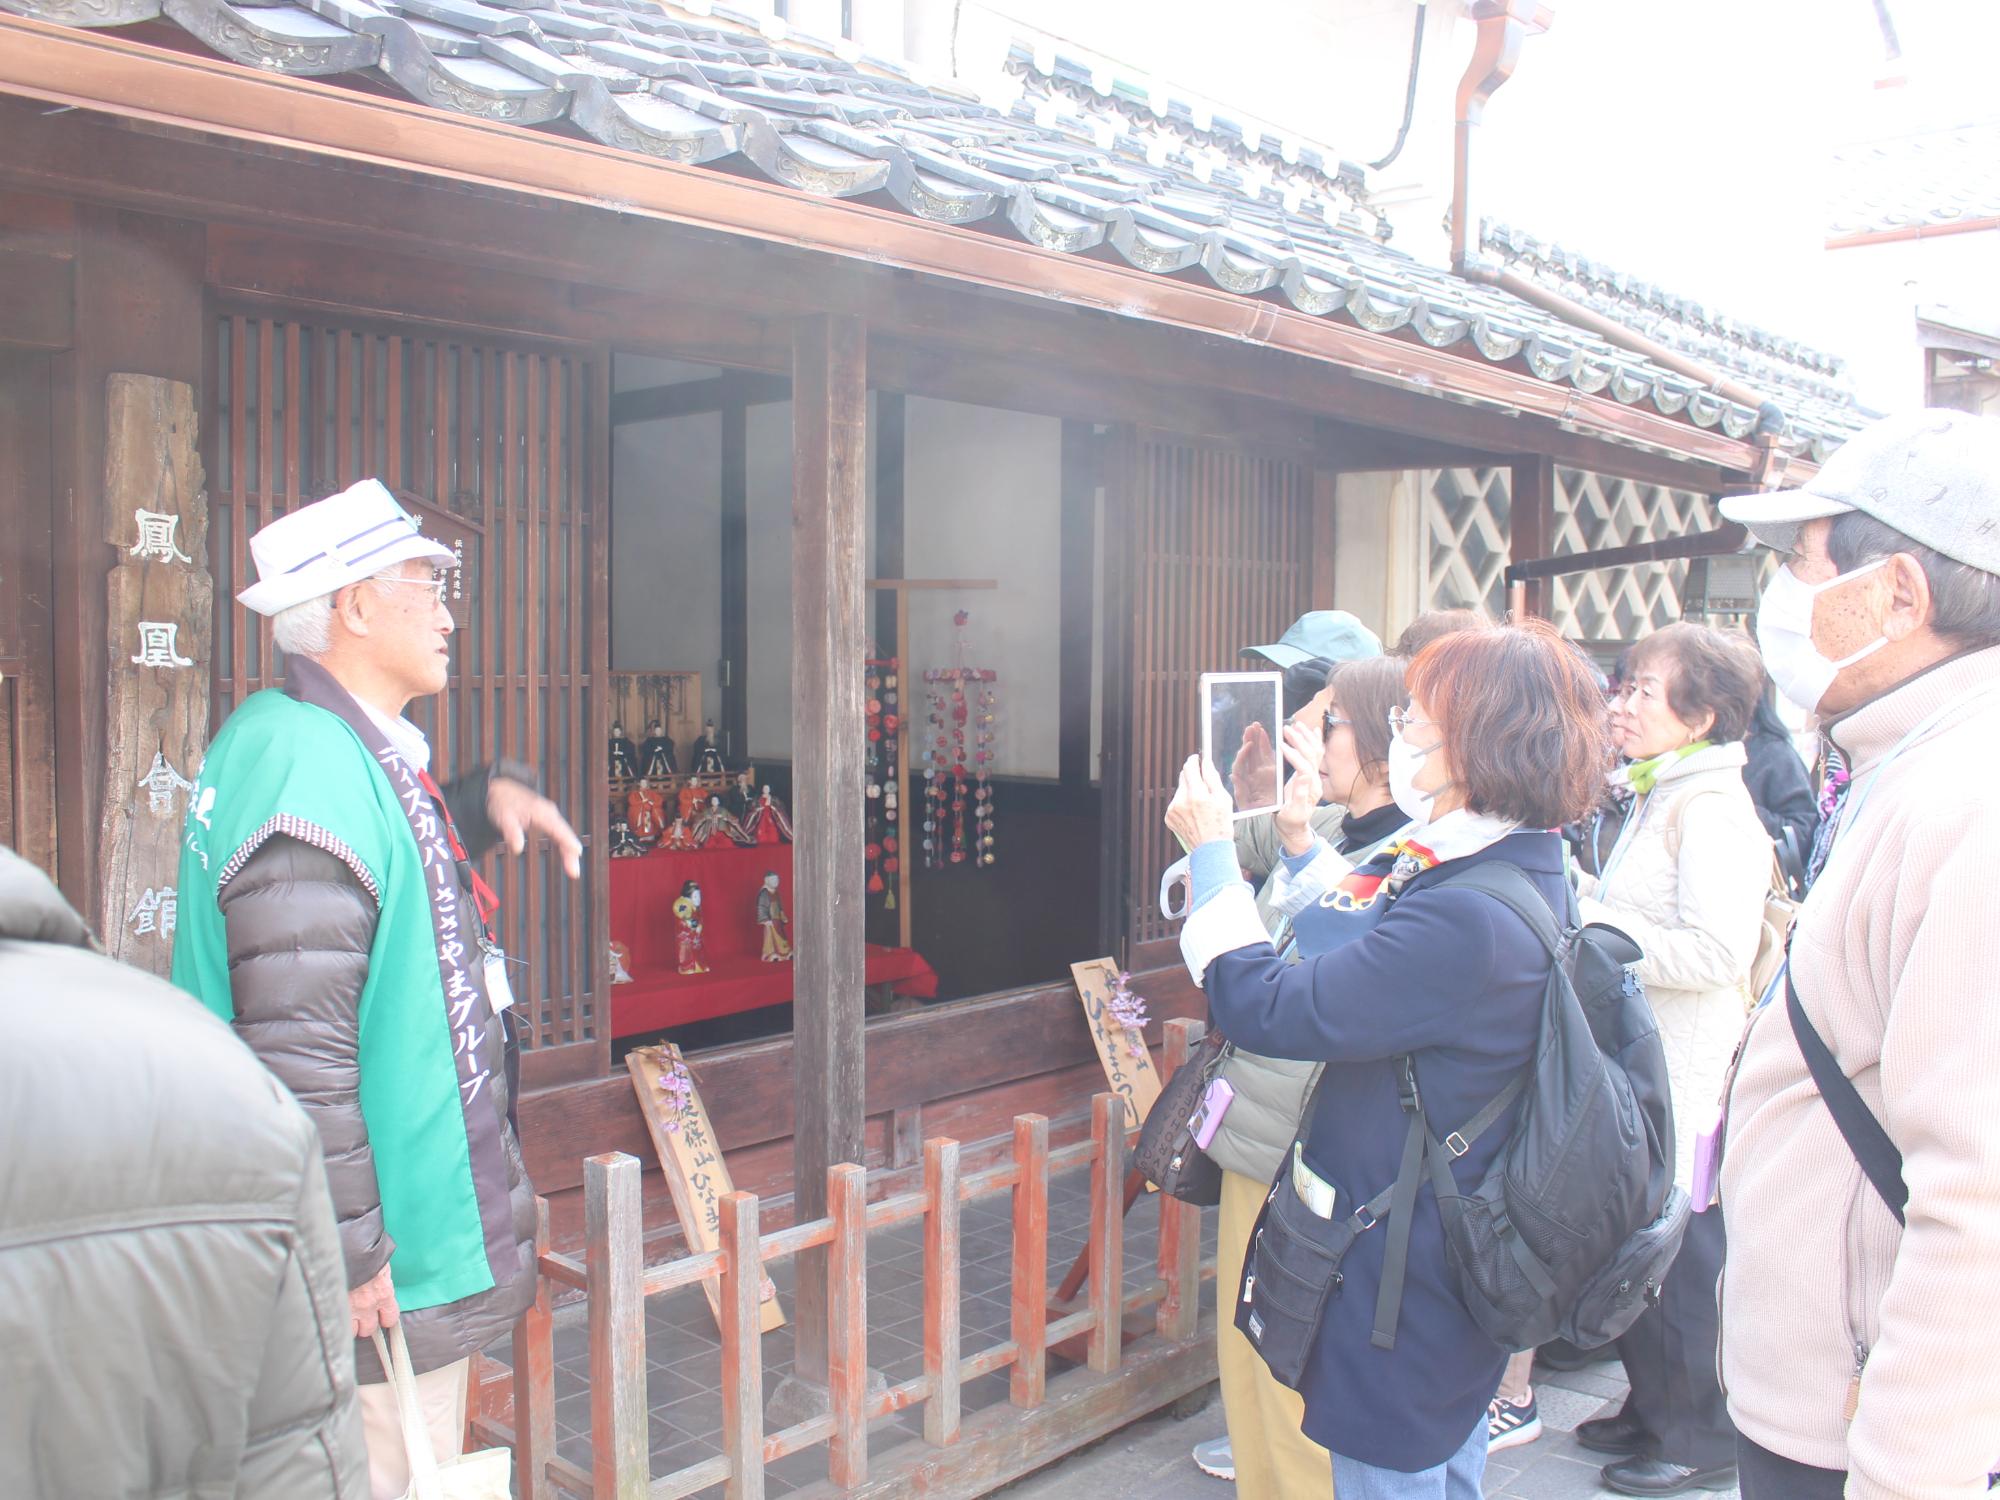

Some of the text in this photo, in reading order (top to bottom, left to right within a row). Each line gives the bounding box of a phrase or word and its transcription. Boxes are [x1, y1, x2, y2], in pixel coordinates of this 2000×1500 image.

[378, 746, 490, 1106] ディスカバーささやまグループ
